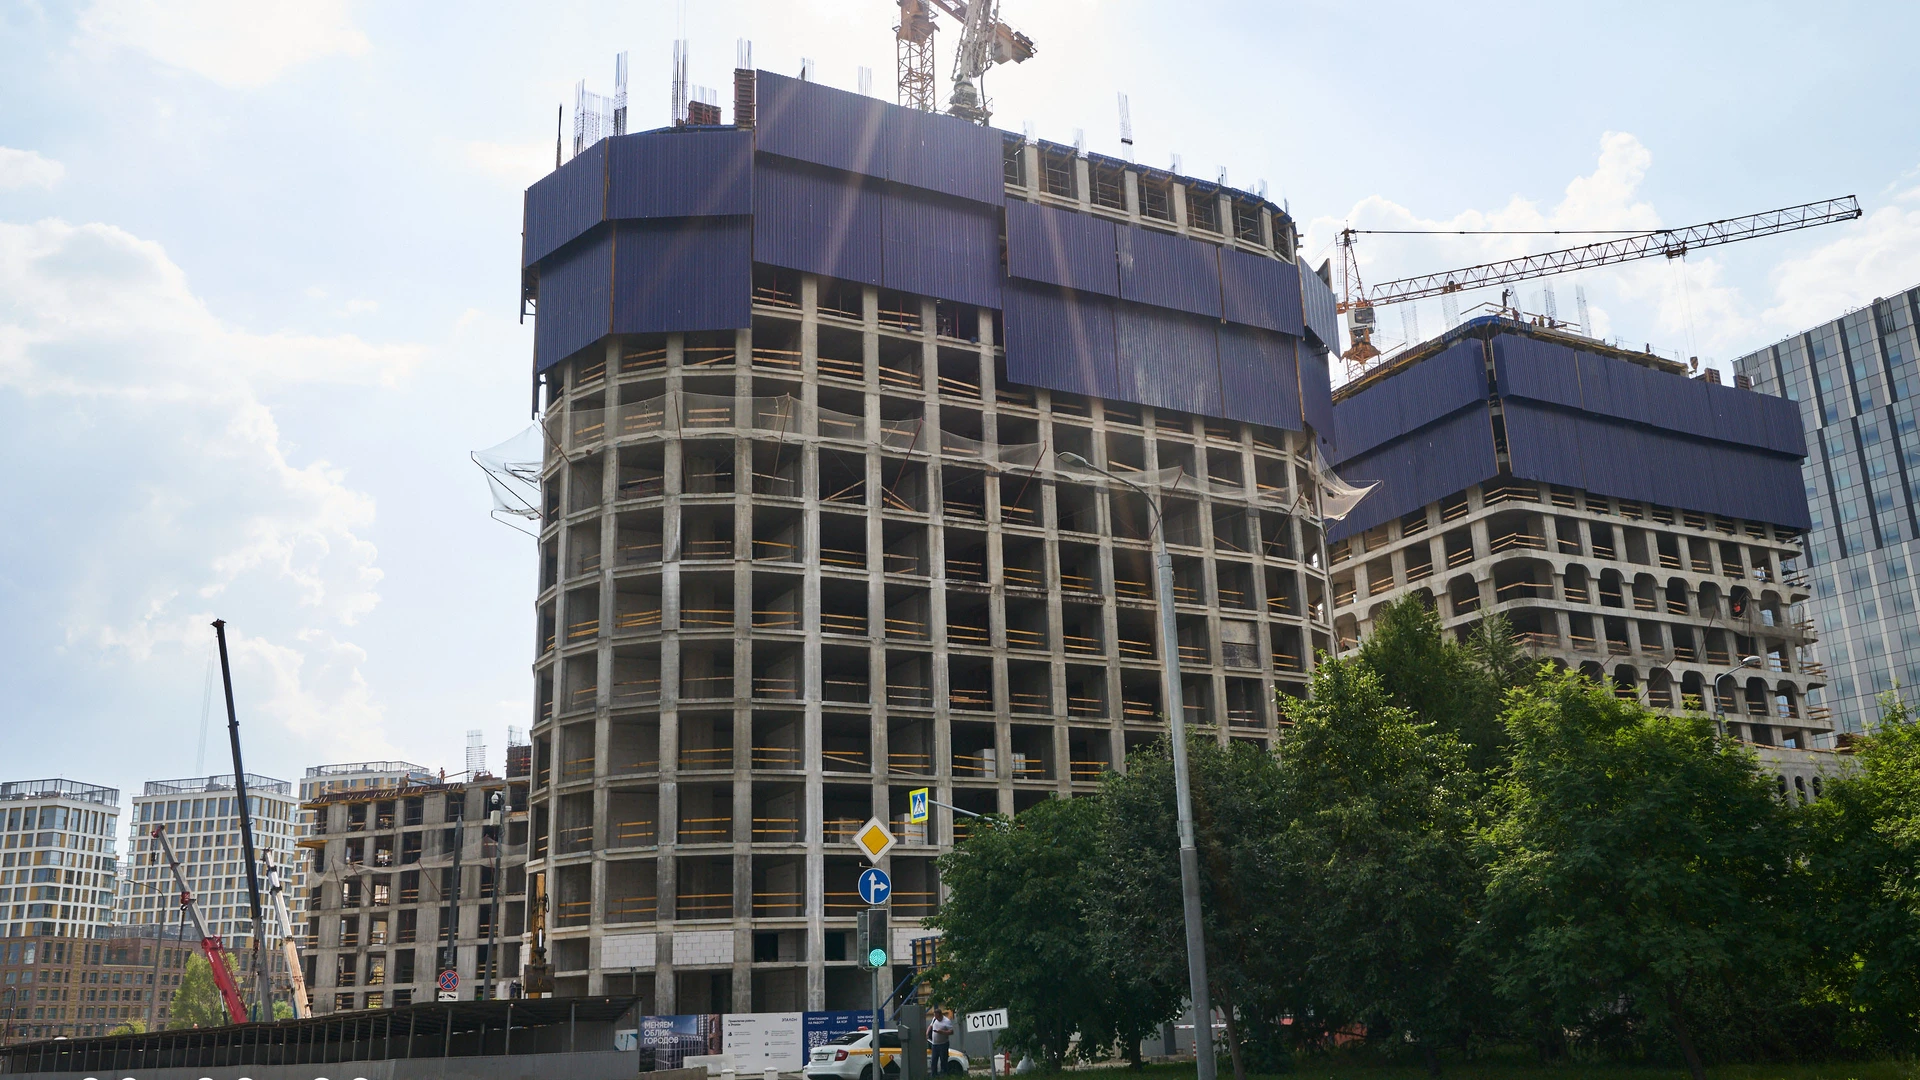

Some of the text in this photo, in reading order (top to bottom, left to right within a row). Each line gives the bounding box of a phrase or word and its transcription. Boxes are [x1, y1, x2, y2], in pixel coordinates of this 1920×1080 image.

[644, 1021, 674, 1029] МЕНЯЕМ
[972, 1013, 1002, 1029] СТОП
[644, 1029, 670, 1037] ОБЛИК
[643, 1036, 679, 1045] ГОРОДОВ
